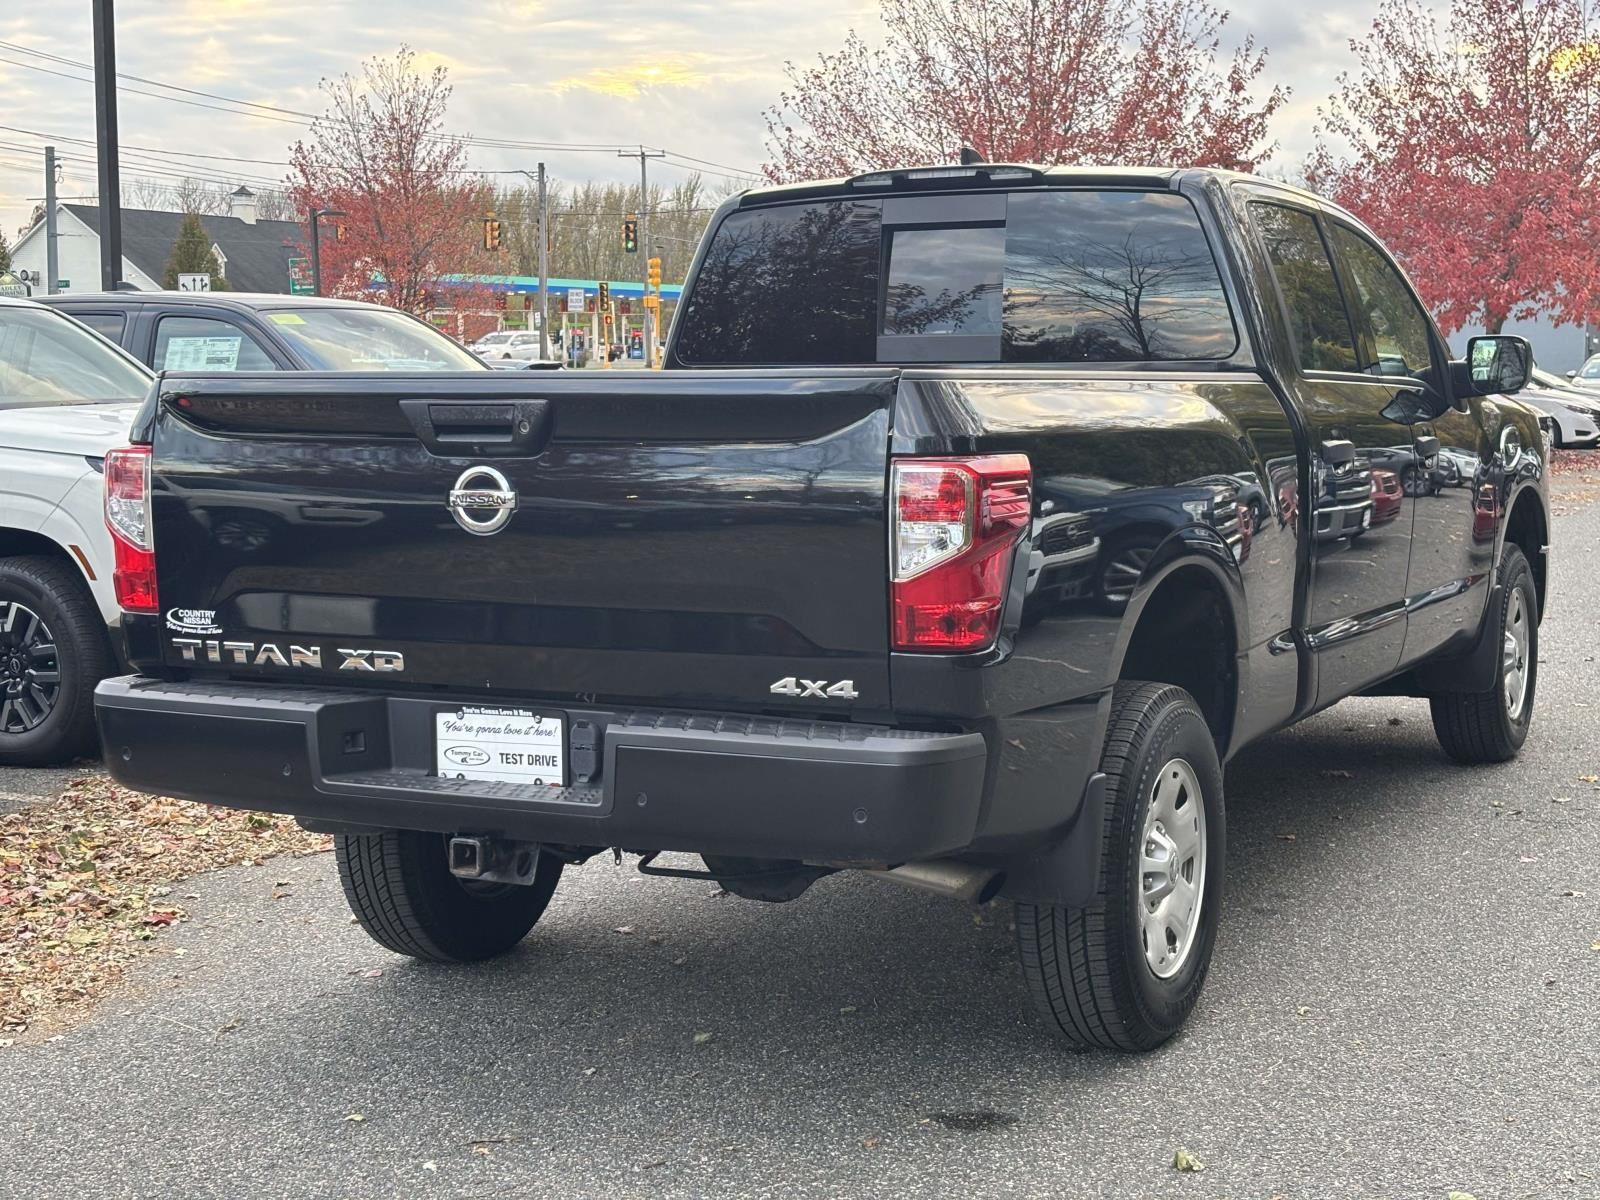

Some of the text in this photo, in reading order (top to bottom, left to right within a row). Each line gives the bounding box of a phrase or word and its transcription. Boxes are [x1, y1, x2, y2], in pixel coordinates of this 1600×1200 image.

[455, 495, 507, 505] NISSAN
[178, 609, 216, 618] COUNTRY
[183, 617, 212, 625] NISSAN
[172, 638, 405, 672] TITAN XD
[442, 720, 558, 738] You're gonna love it here!
[499, 752, 558, 767] TEST DRIVE
